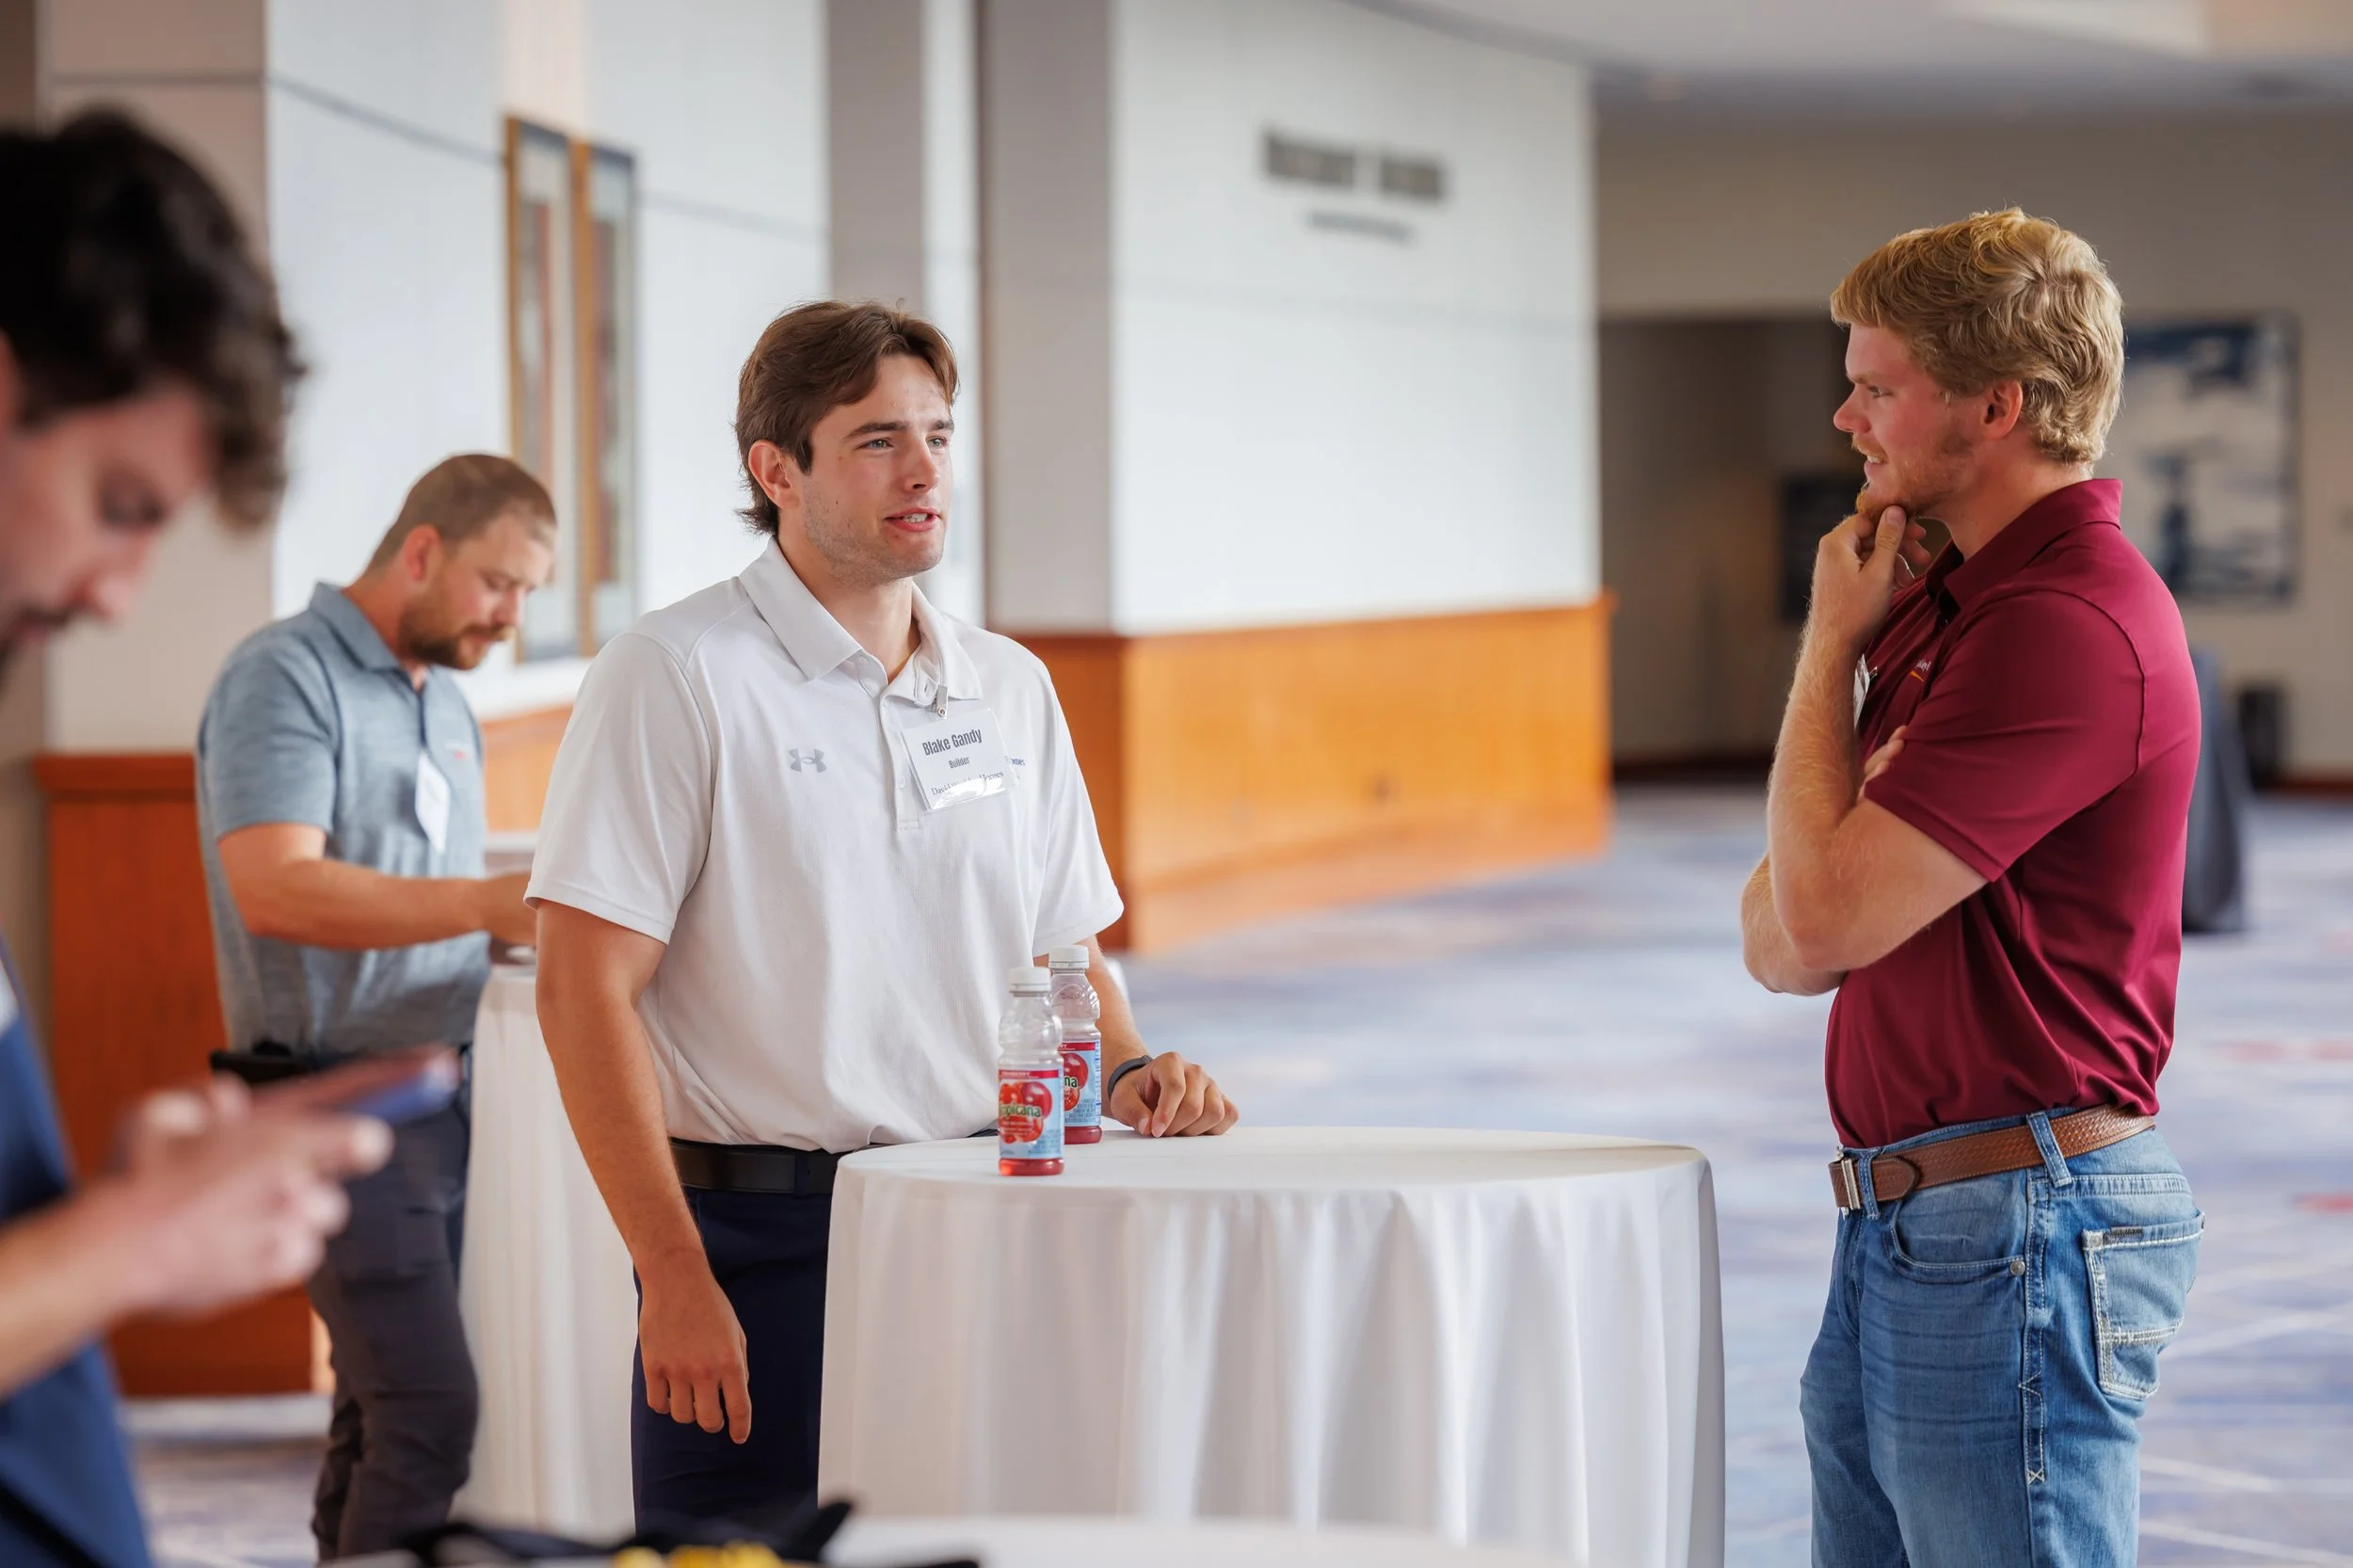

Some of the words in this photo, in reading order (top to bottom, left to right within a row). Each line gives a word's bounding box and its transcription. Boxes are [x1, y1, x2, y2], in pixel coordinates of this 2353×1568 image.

[922, 738, 951, 756] Blake
[952, 729, 983, 748] Gandy
[949, 757, 970, 769] Builder
